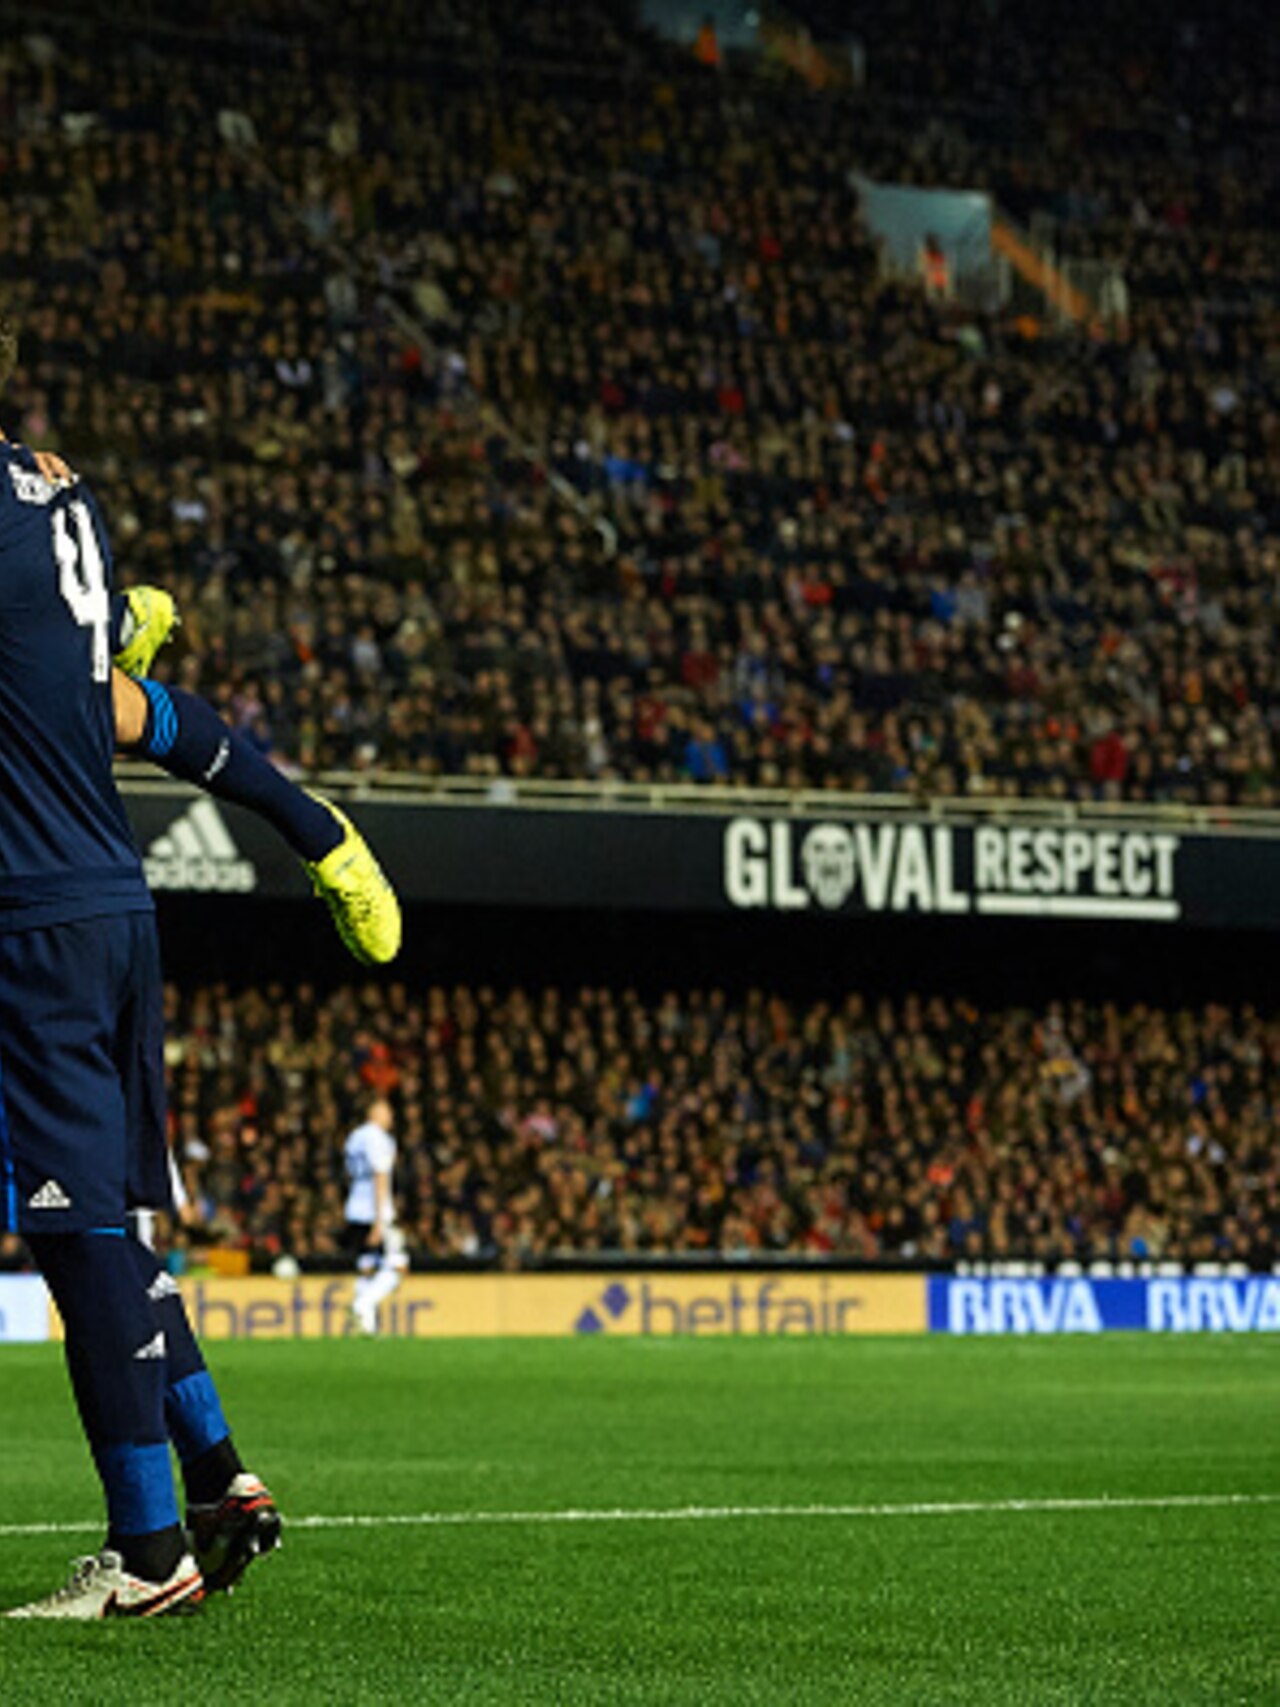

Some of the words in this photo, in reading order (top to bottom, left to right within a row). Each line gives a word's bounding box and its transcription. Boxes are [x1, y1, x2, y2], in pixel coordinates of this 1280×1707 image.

[51, 499, 111, 683] 4
[973, 827, 1180, 897] RESPECT
[641, 1277, 862, 1337] betfair
[947, 1278, 1104, 1333] BBVA
